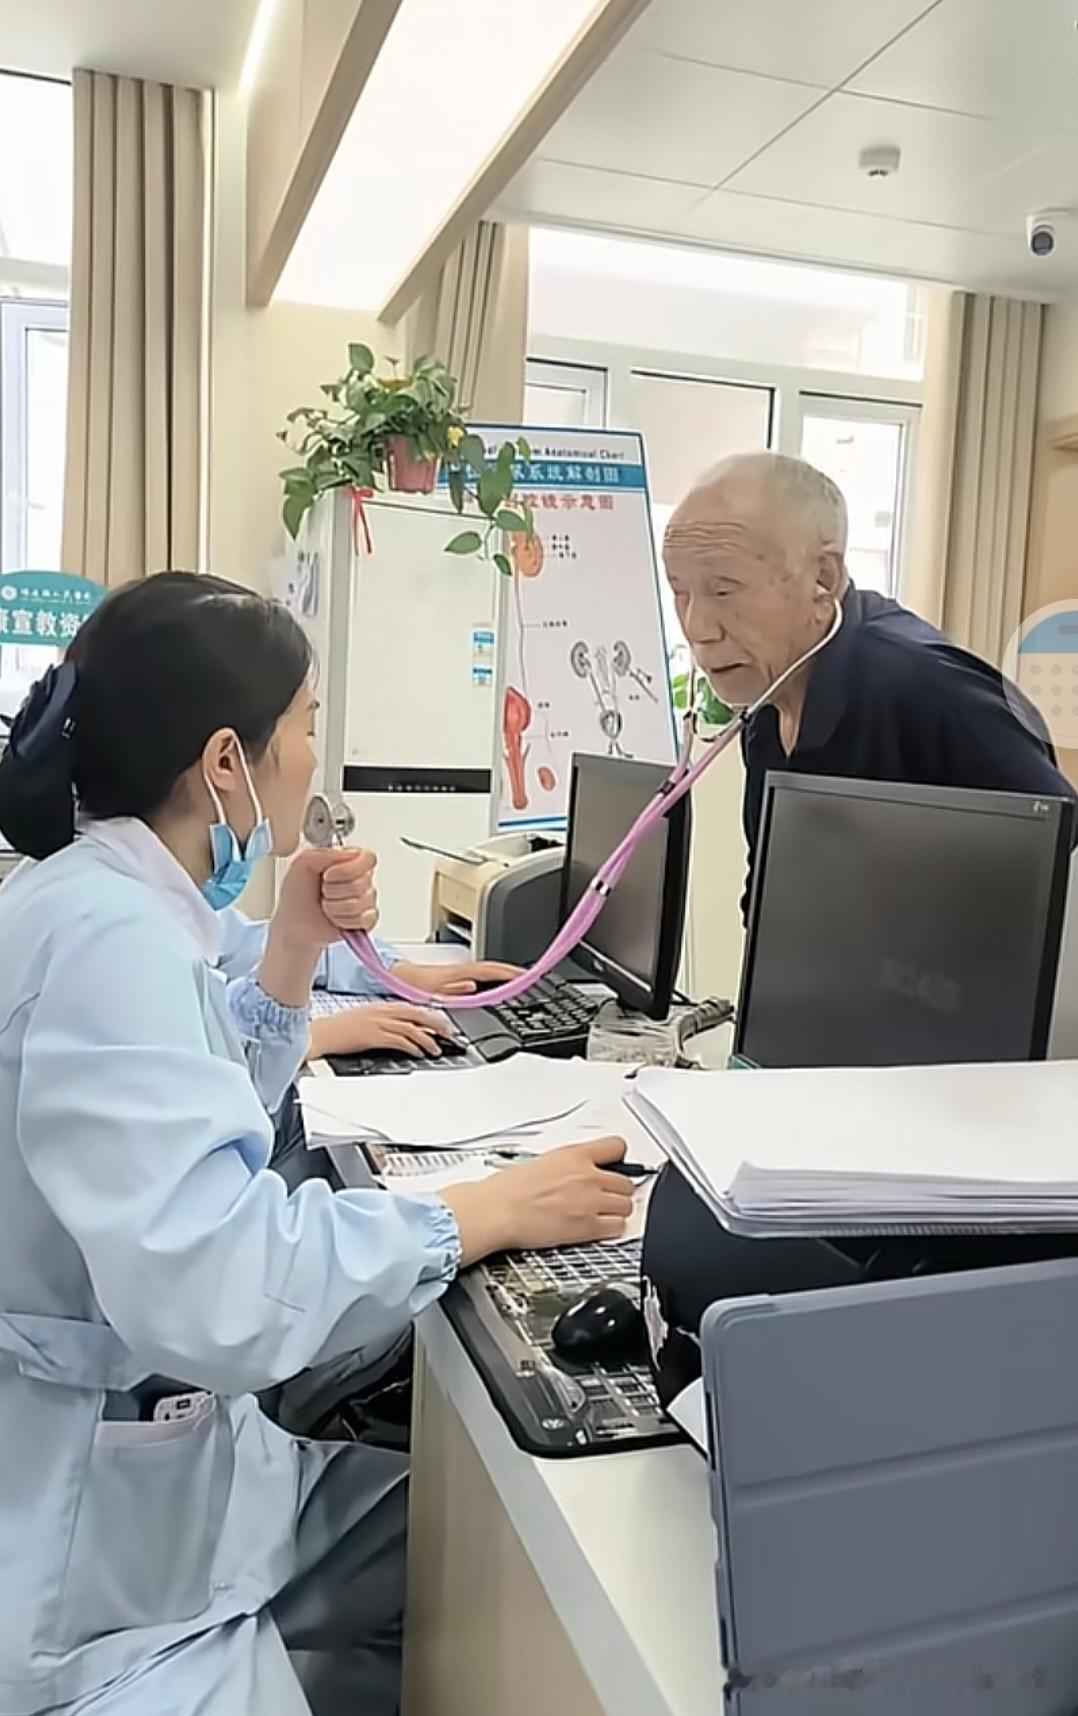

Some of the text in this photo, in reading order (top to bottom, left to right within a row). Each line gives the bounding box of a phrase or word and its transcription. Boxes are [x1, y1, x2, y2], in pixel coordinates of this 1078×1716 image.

[544, 446, 597, 459] Anatomical
[600, 449, 625, 460] Chart
[0, 607, 88, 637] 宣教资
